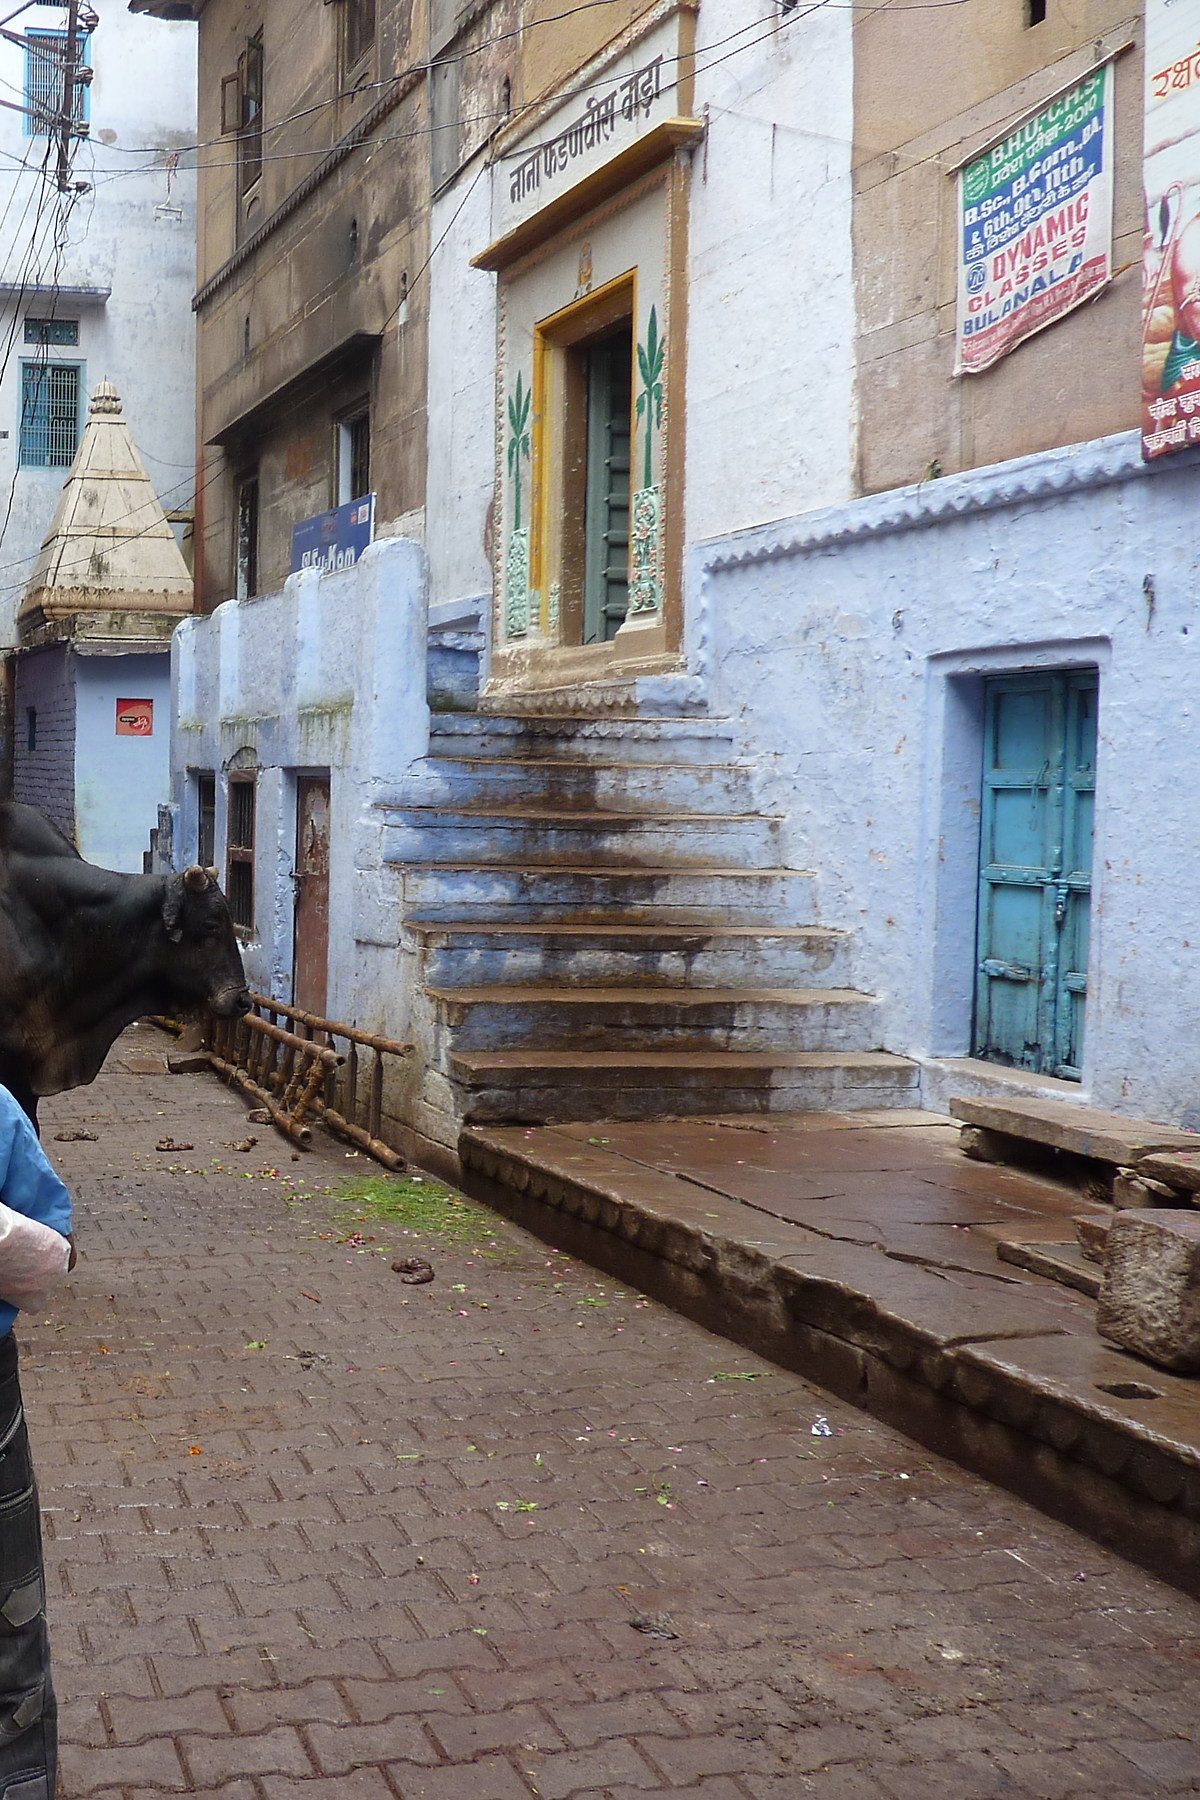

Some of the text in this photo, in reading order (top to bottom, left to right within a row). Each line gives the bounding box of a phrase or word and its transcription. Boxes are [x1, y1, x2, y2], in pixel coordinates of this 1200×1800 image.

[509, 149, 542, 203] नाना
[968, 225, 1086, 313] CLASSES
[993, 192, 1089, 282] DYNAMIC
[963, 252, 1084, 335] BULANALA
